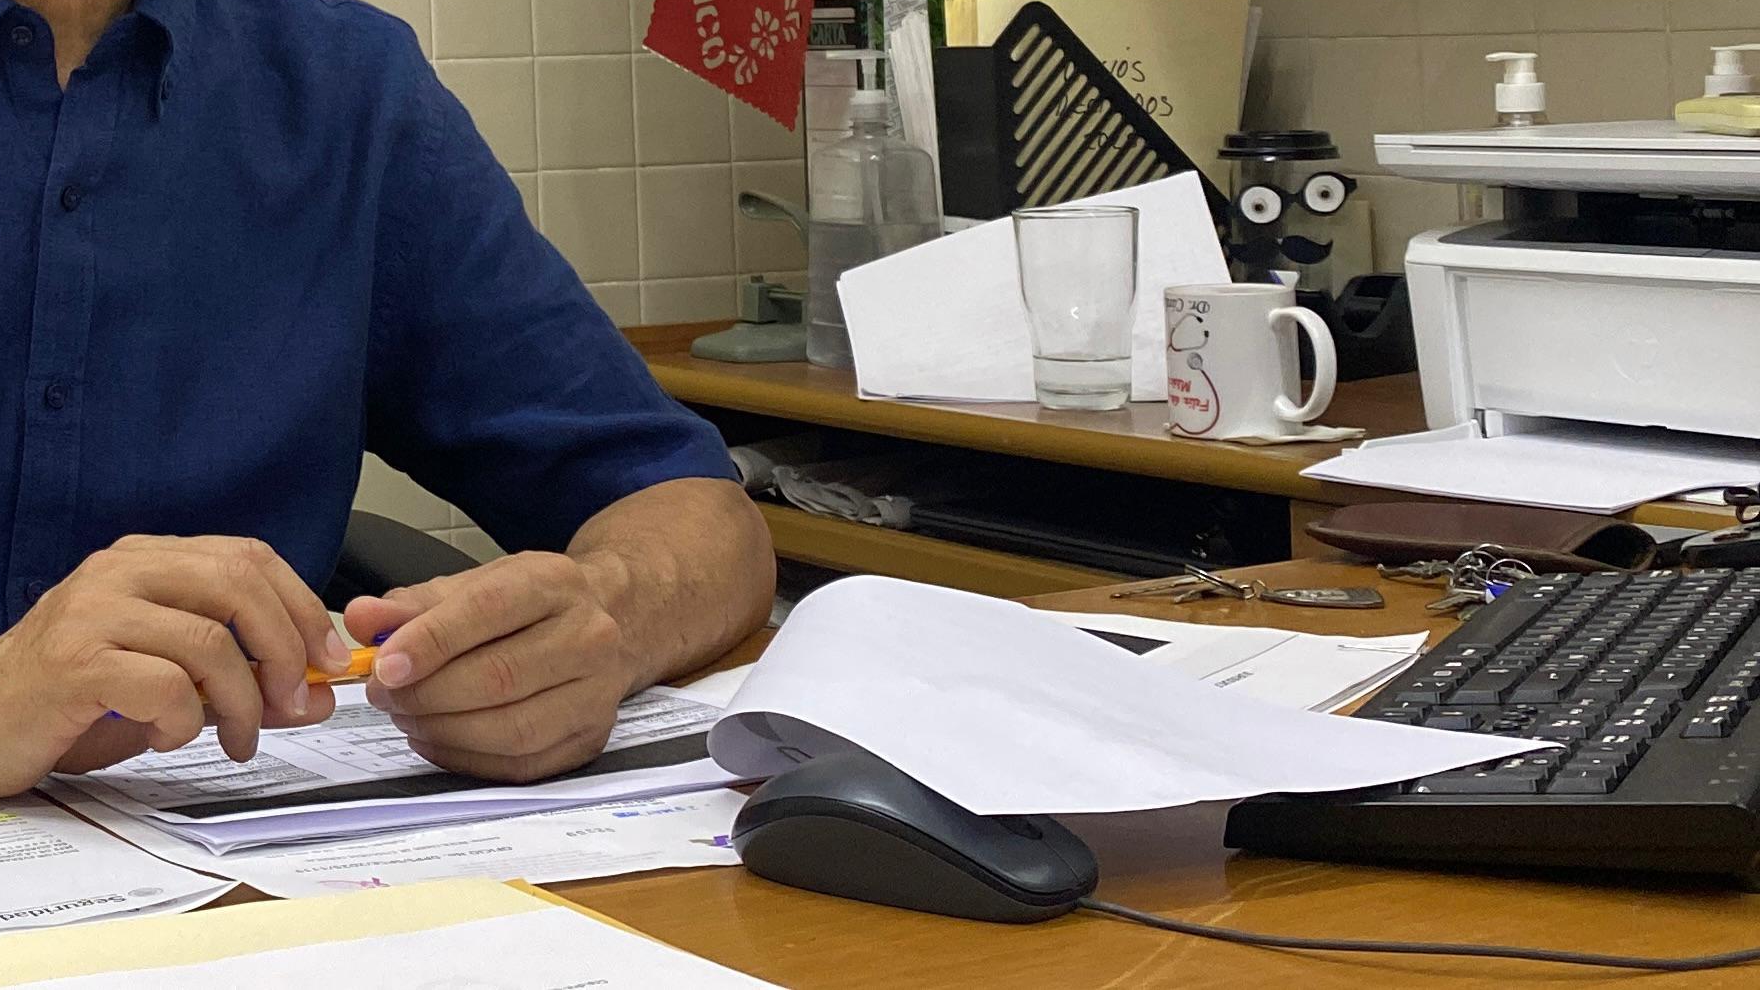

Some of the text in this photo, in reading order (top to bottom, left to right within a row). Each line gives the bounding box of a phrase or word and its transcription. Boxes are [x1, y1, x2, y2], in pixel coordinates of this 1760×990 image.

[809, 23, 847, 45] CARTA
[1187, 300, 1211, 314] Dr.
[1183, 396, 1210, 412] Feliz
